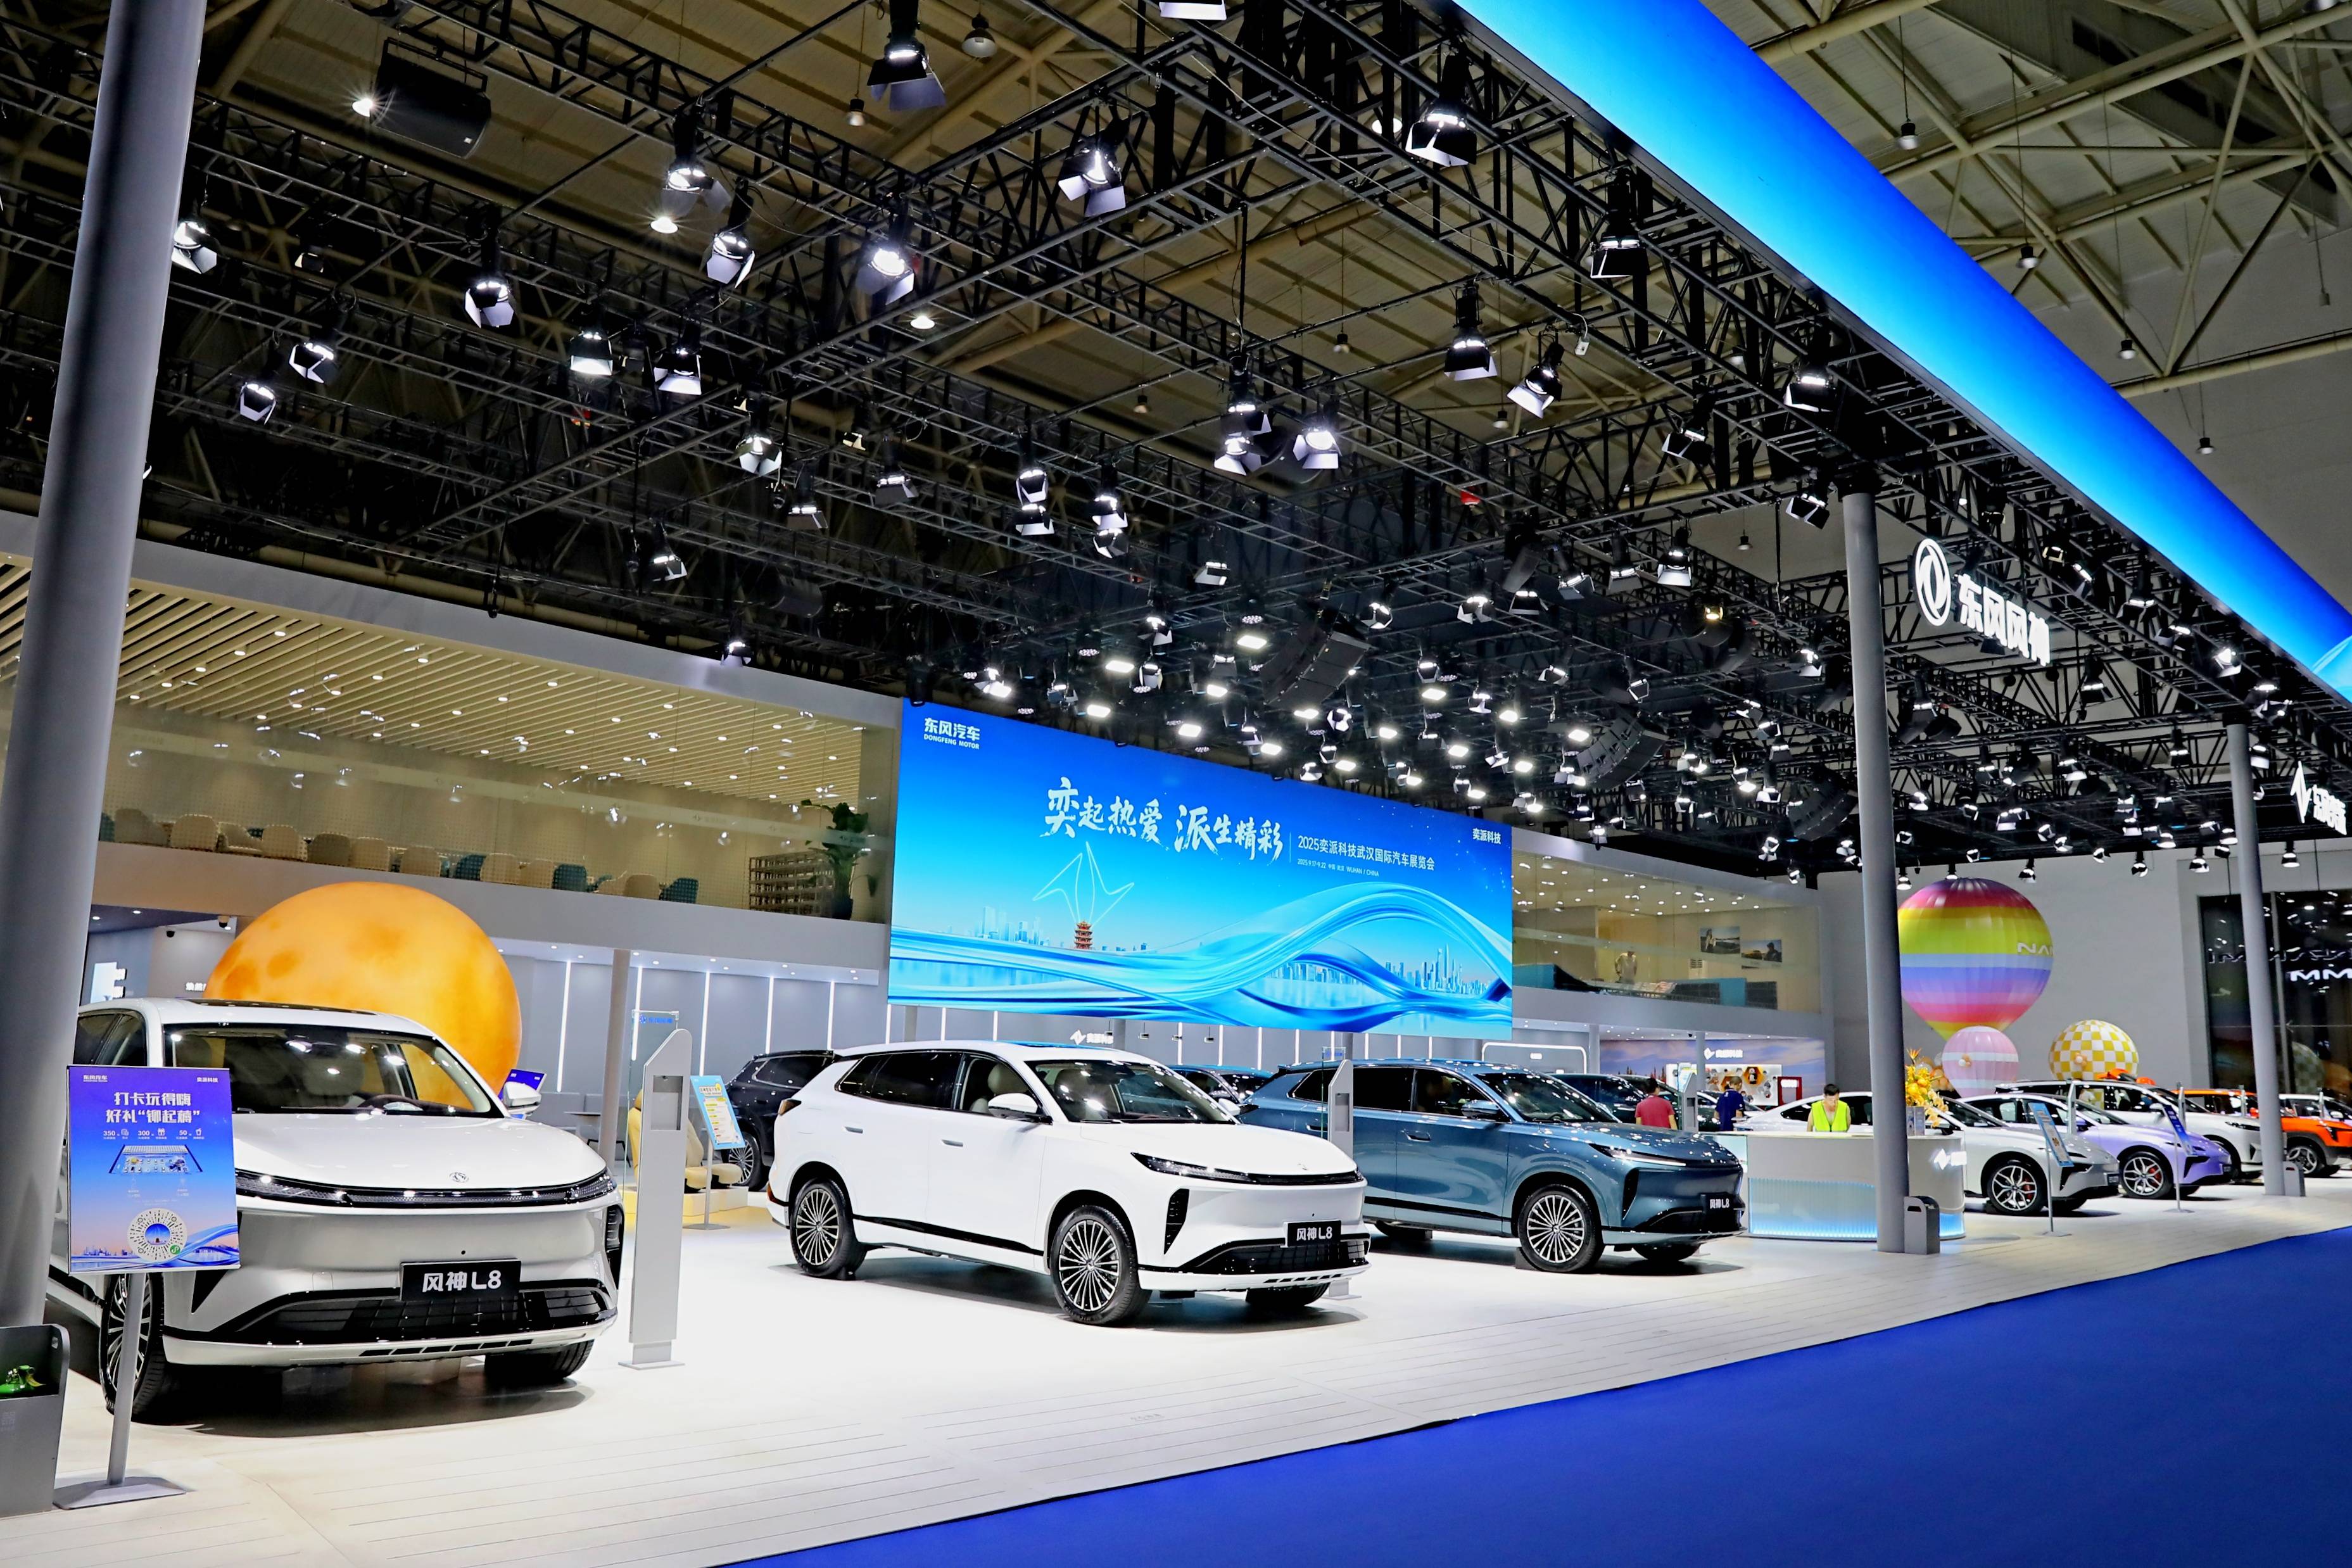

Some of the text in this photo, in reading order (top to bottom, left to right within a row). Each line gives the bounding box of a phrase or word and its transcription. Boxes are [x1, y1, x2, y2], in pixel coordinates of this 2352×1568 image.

[1957, 573, 2051, 667] 东风风神
[925, 718, 980, 741] 东风汽车
[924, 733, 980, 750] DONGFENG MOTOR
[1039, 776, 1284, 866] 奕起热爱 派生精彩
[1472, 828, 1502, 845] 奕派科技
[1298, 835, 1435, 871] 2025奕派科技武汉国际汽车展览会
[1346, 866, 1363, 875] WUHAN
[114, 1092, 191, 1106] 打卡玩得嗨
[1721, 1198, 1730, 1208] L8
[1296, 1226, 1332, 1241] 风神 L8
[422, 1270, 502, 1293] 风神 L8
